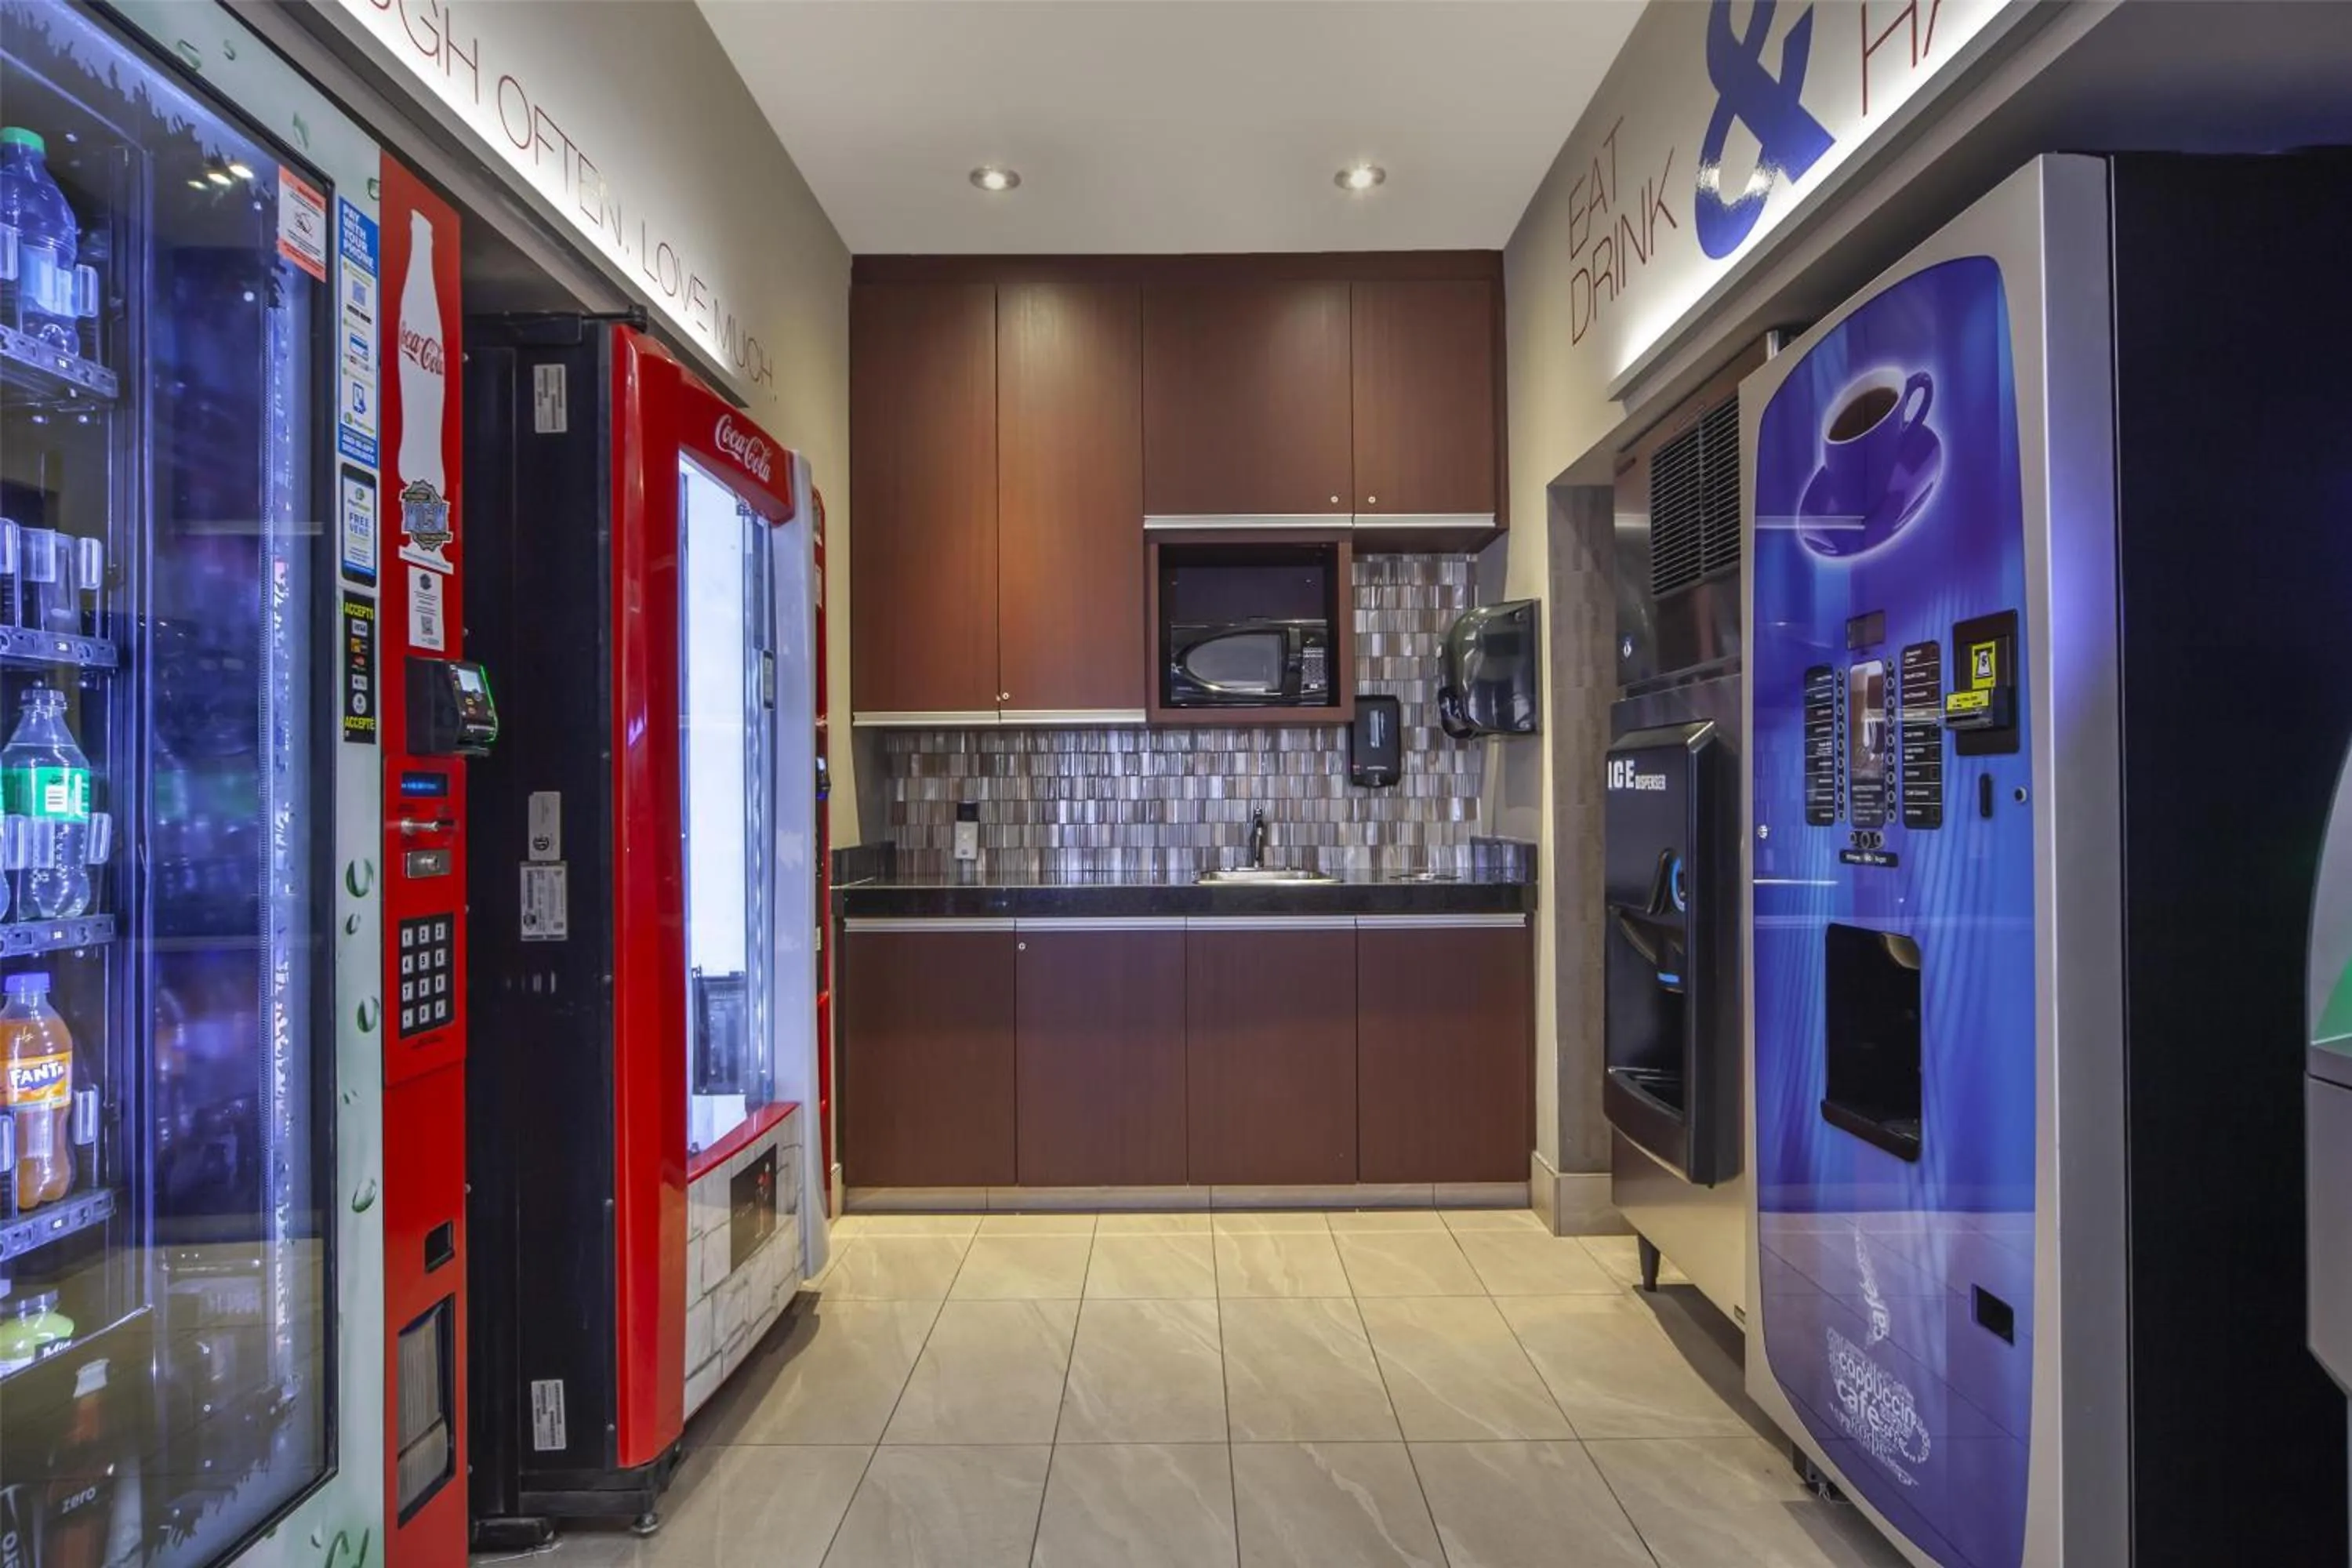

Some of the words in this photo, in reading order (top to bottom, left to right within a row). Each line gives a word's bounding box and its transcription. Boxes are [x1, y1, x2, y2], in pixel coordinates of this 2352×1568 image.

[371, 0, 479, 105] GH
[498, 75, 630, 255] OFTEN,
[642, 220, 707, 332] LOVE
[714, 298, 772, 387] MUCH
[1569, 116, 1624, 261] EAT
[1570, 146, 1678, 345] DRINK
[714, 413, 773, 484] Coca-Cola
[349, 512, 369, 528] FREE
[344, 602, 375, 619] ACCEPTS
[1608, 759, 1635, 790] ICE
[1837, 1378, 1880, 1431] café
[62, 1486, 96, 1514] zero
